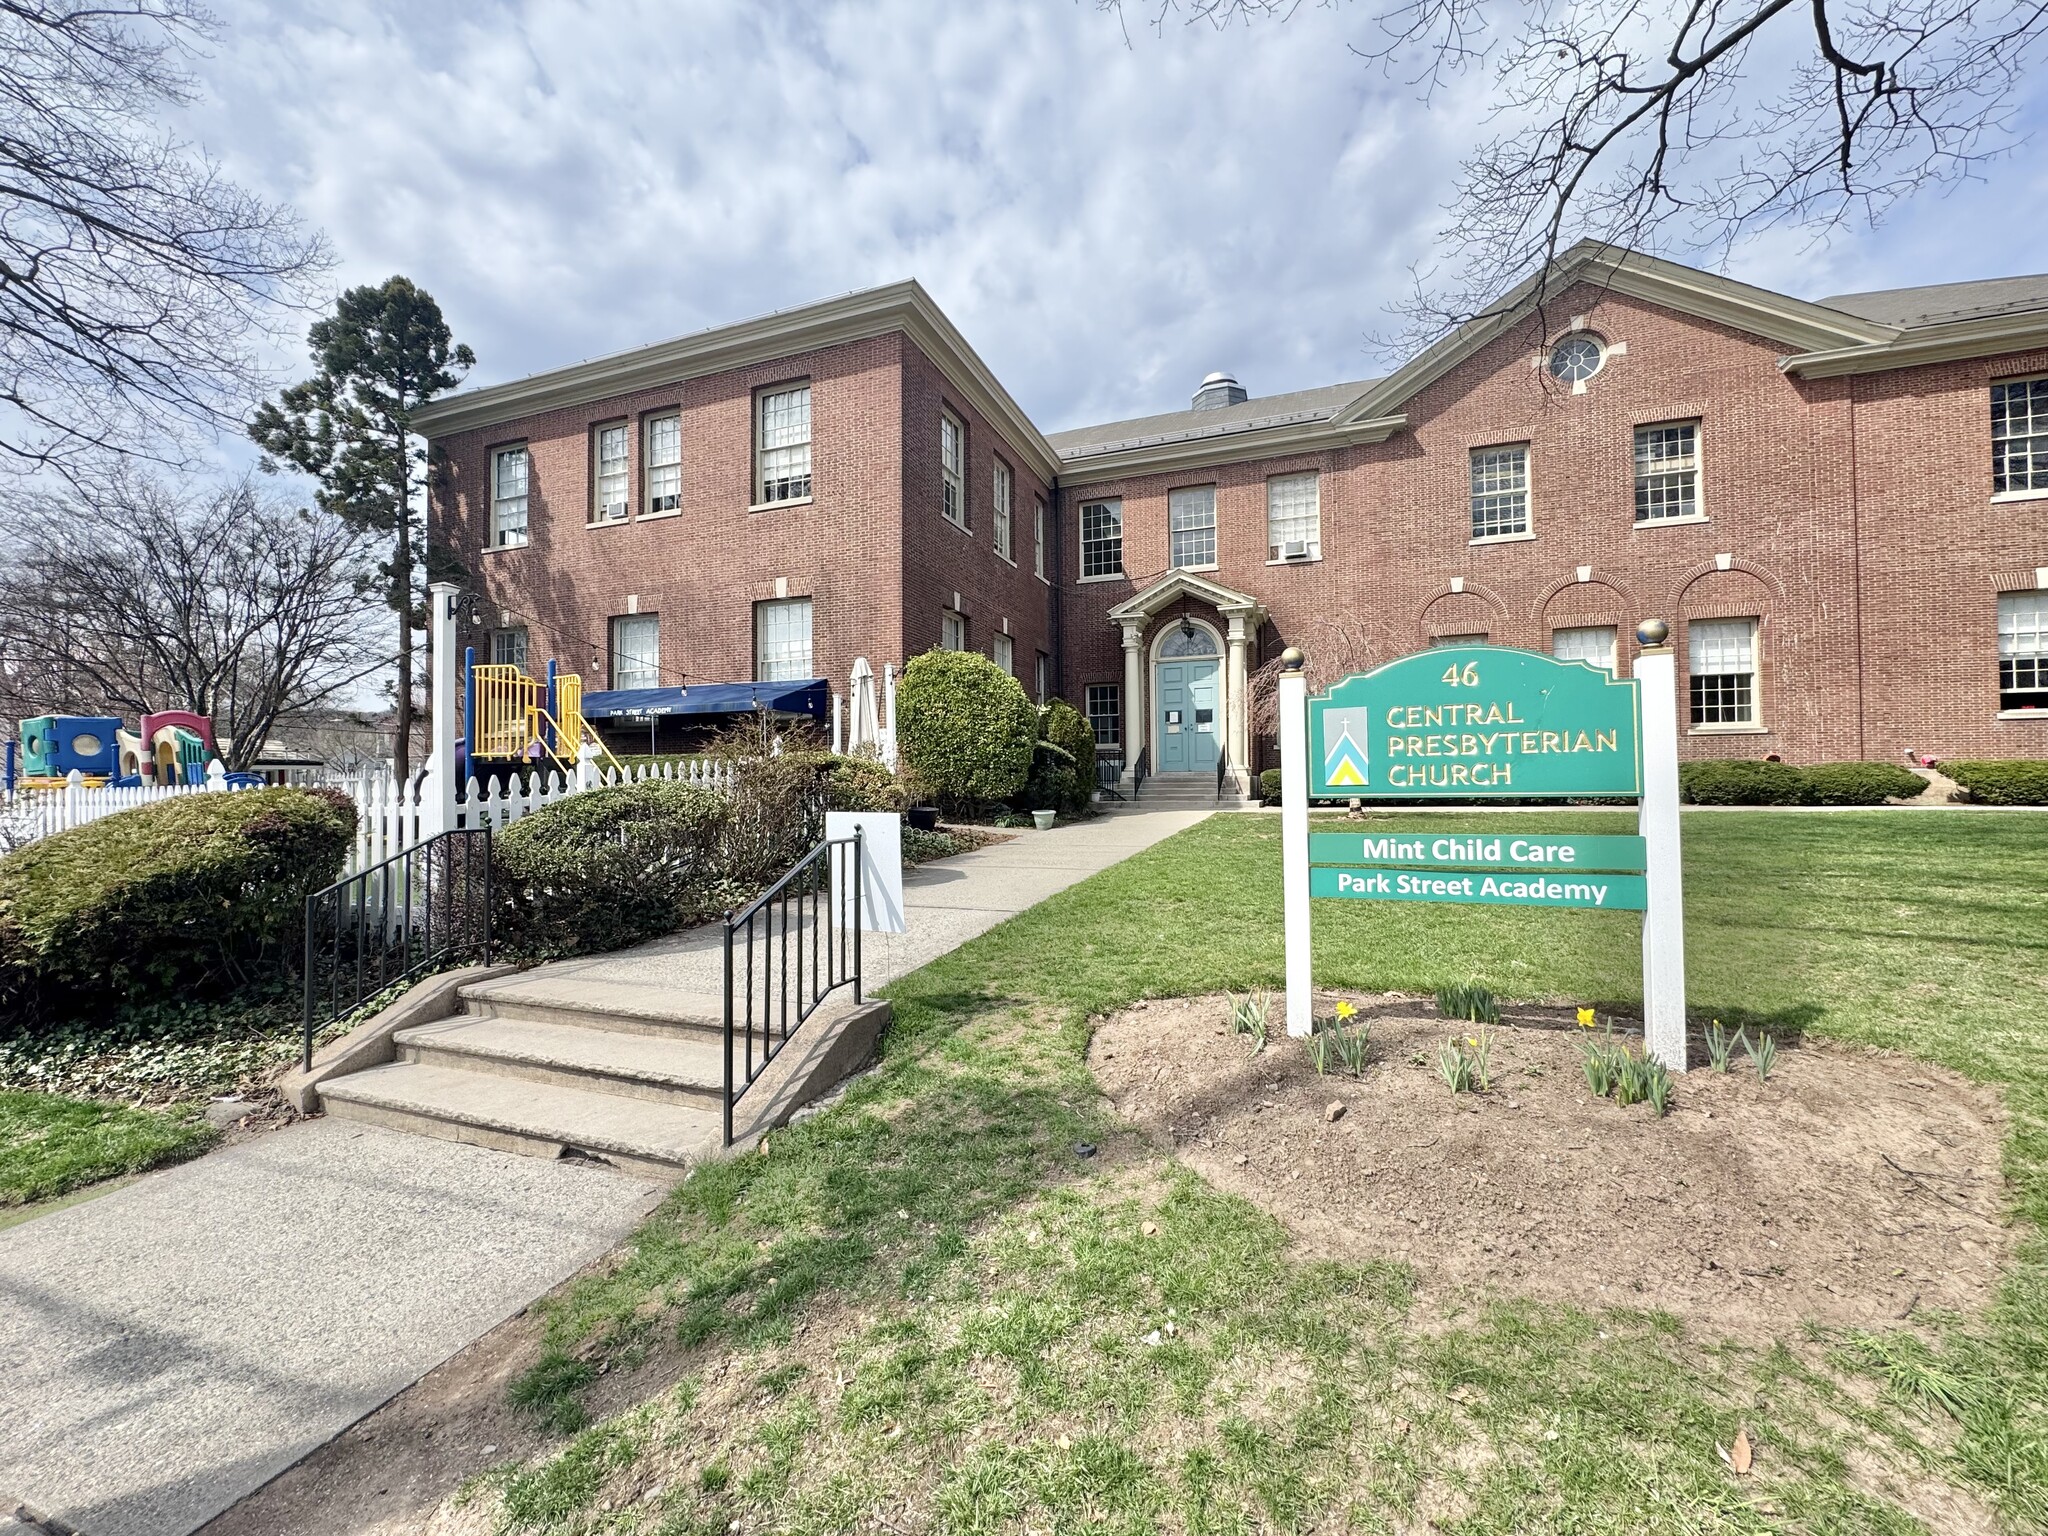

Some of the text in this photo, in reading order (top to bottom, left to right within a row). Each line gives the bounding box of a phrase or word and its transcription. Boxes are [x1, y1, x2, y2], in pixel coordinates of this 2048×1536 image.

[1441, 661, 1479, 687] 46
[625, 708, 642, 716] STREET
[645, 707, 672, 715] ACADEMY
[1385, 701, 1524, 728] CENTRAL
[1388, 728, 1617, 758] PRESBYTERIAN
[1388, 763, 1512, 787] CHURCH
[1363, 838, 1576, 863] Mint Child Care
[1338, 873, 1608, 905] Park Street Academy
